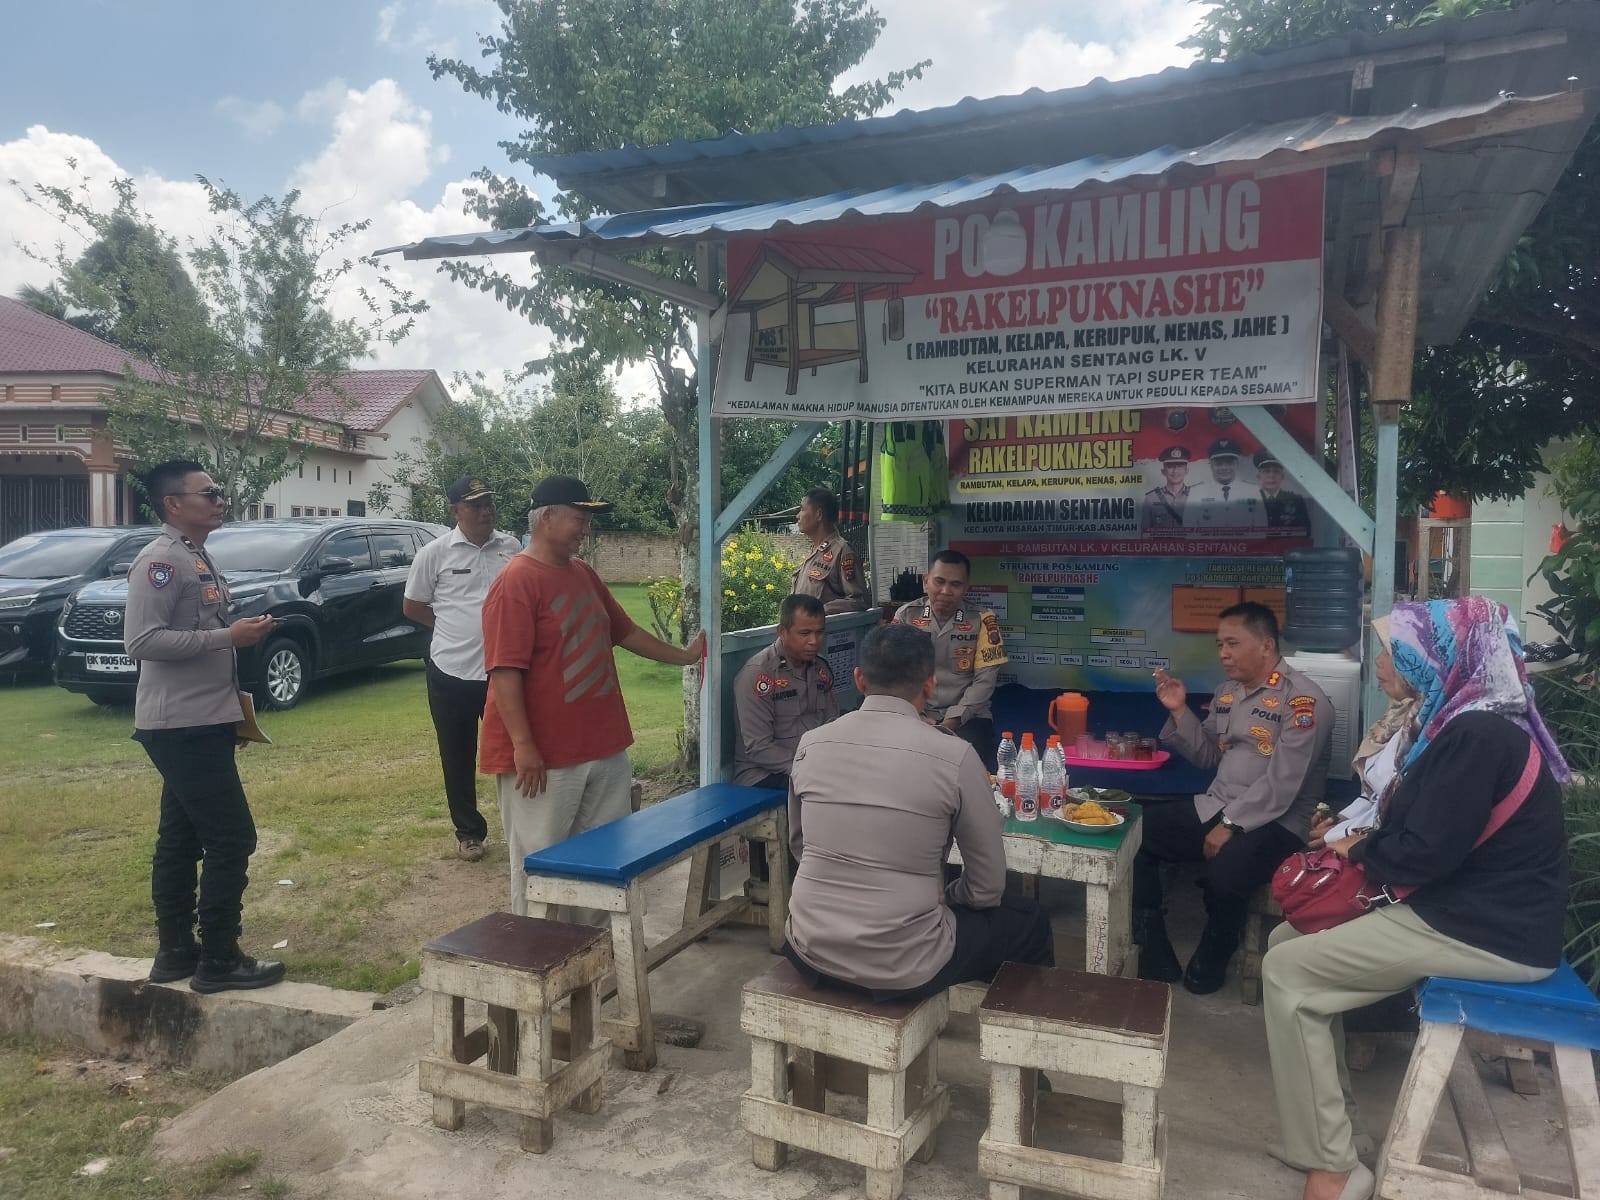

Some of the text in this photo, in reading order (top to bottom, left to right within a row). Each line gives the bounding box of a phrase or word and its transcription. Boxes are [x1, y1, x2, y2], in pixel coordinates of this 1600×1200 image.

[934, 180, 1261, 281] PO KAMLING
[1006, 331, 1069, 353] KELAPA,
[1074, 325, 1160, 348] KERUPUK,
[1165, 320, 1227, 342] NENAS,
[966, 347, 1207, 375] KELURAHAN SENTANG LK. V
[959, 380, 1009, 395] BUKAN
[1014, 374, 1101, 391] SUPERMAN
[1107, 371, 1142, 386] TAPI
[1147, 368, 1205, 383] SUPER
[791, 402, 825, 413] MAKNA
[827, 401, 855, 412] HIDUP
[857, 401, 898, 413] MANUSIA
[901, 399, 959, 412] DITENTUKAN
[961, 399, 987, 409] OLEH
[989, 394, 1056, 407] KEMAMPUAN
[1058, 391, 1104, 403] MEREKA
[1106, 389, 1143, 401] UNTUK
[1146, 385, 1188, 398] PEDULI
[1190, 384, 1238, 397] KEPADA
[1016, 409, 1141, 438] KAMLING
[968, 440, 1134, 474] RAKELPUKNASHE
[960, 475, 1143, 489] RAMBUTAN, KELAPA, KERUPUK, NENAS, JAHE
[966, 498, 1135, 523] KELURAHAN SENTANG
[1006, 525, 1045, 533] KISARAN
[1017, 543, 1078, 553] RAMBUTAN
[1100, 543, 1110, 552] V
[1111, 543, 1185, 553] KELURAHAN
[1187, 542, 1249, 553] SENTANG
[1000, 562, 1120, 572] STRUKTUR POS KAMLING
[1018, 573, 1099, 584] RAKELPUKNASHE
[87, 656, 99, 665] BK
[1251, 707, 1282, 723] POLRI
